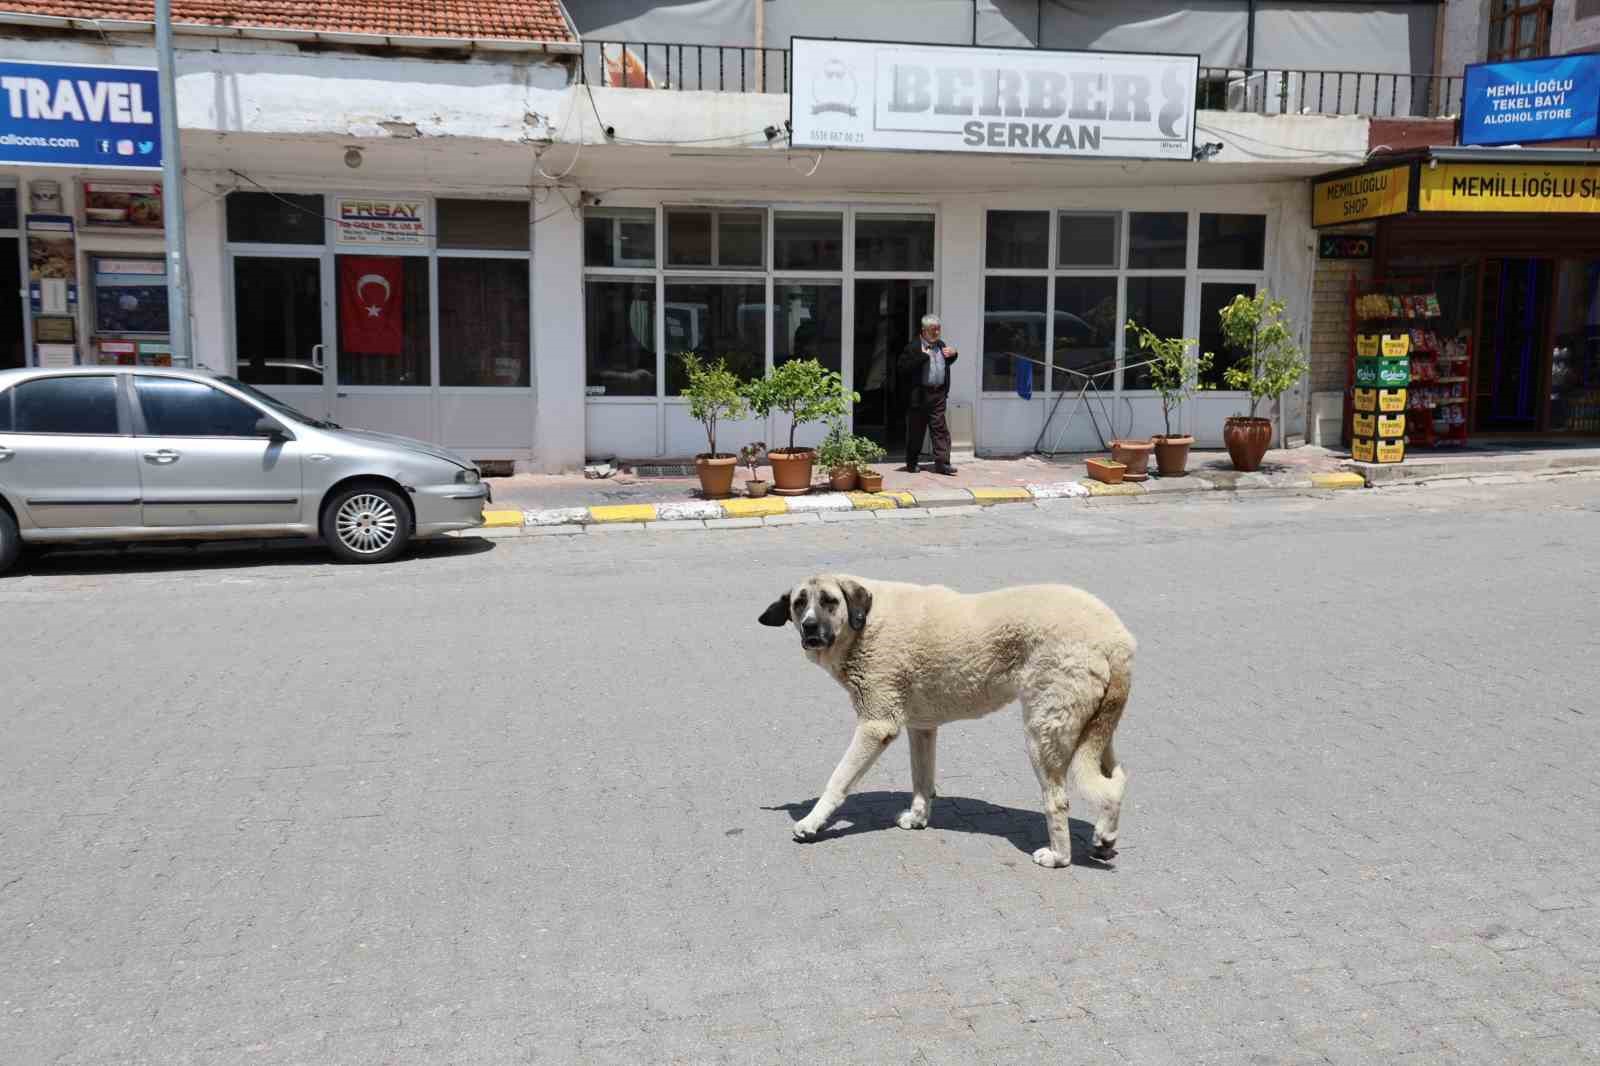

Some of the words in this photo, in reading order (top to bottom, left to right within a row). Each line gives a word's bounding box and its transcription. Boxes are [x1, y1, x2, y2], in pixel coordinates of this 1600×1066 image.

[1, 76, 154, 124] TRAVEL
[888, 64, 1152, 121] BERBER
[1492, 97, 1531, 111] TEKEL
[1534, 92, 1565, 108] BAYİ
[1484, 111, 1533, 124] ALCOHOL
[1535, 108, 1572, 120] STORE
[963, 121, 1101, 150] SERKAN
[1452, 171, 1576, 198] MEMİLLİOĞLU
[341, 201, 417, 217] ERSAY
[1343, 197, 1369, 217] SHOP
